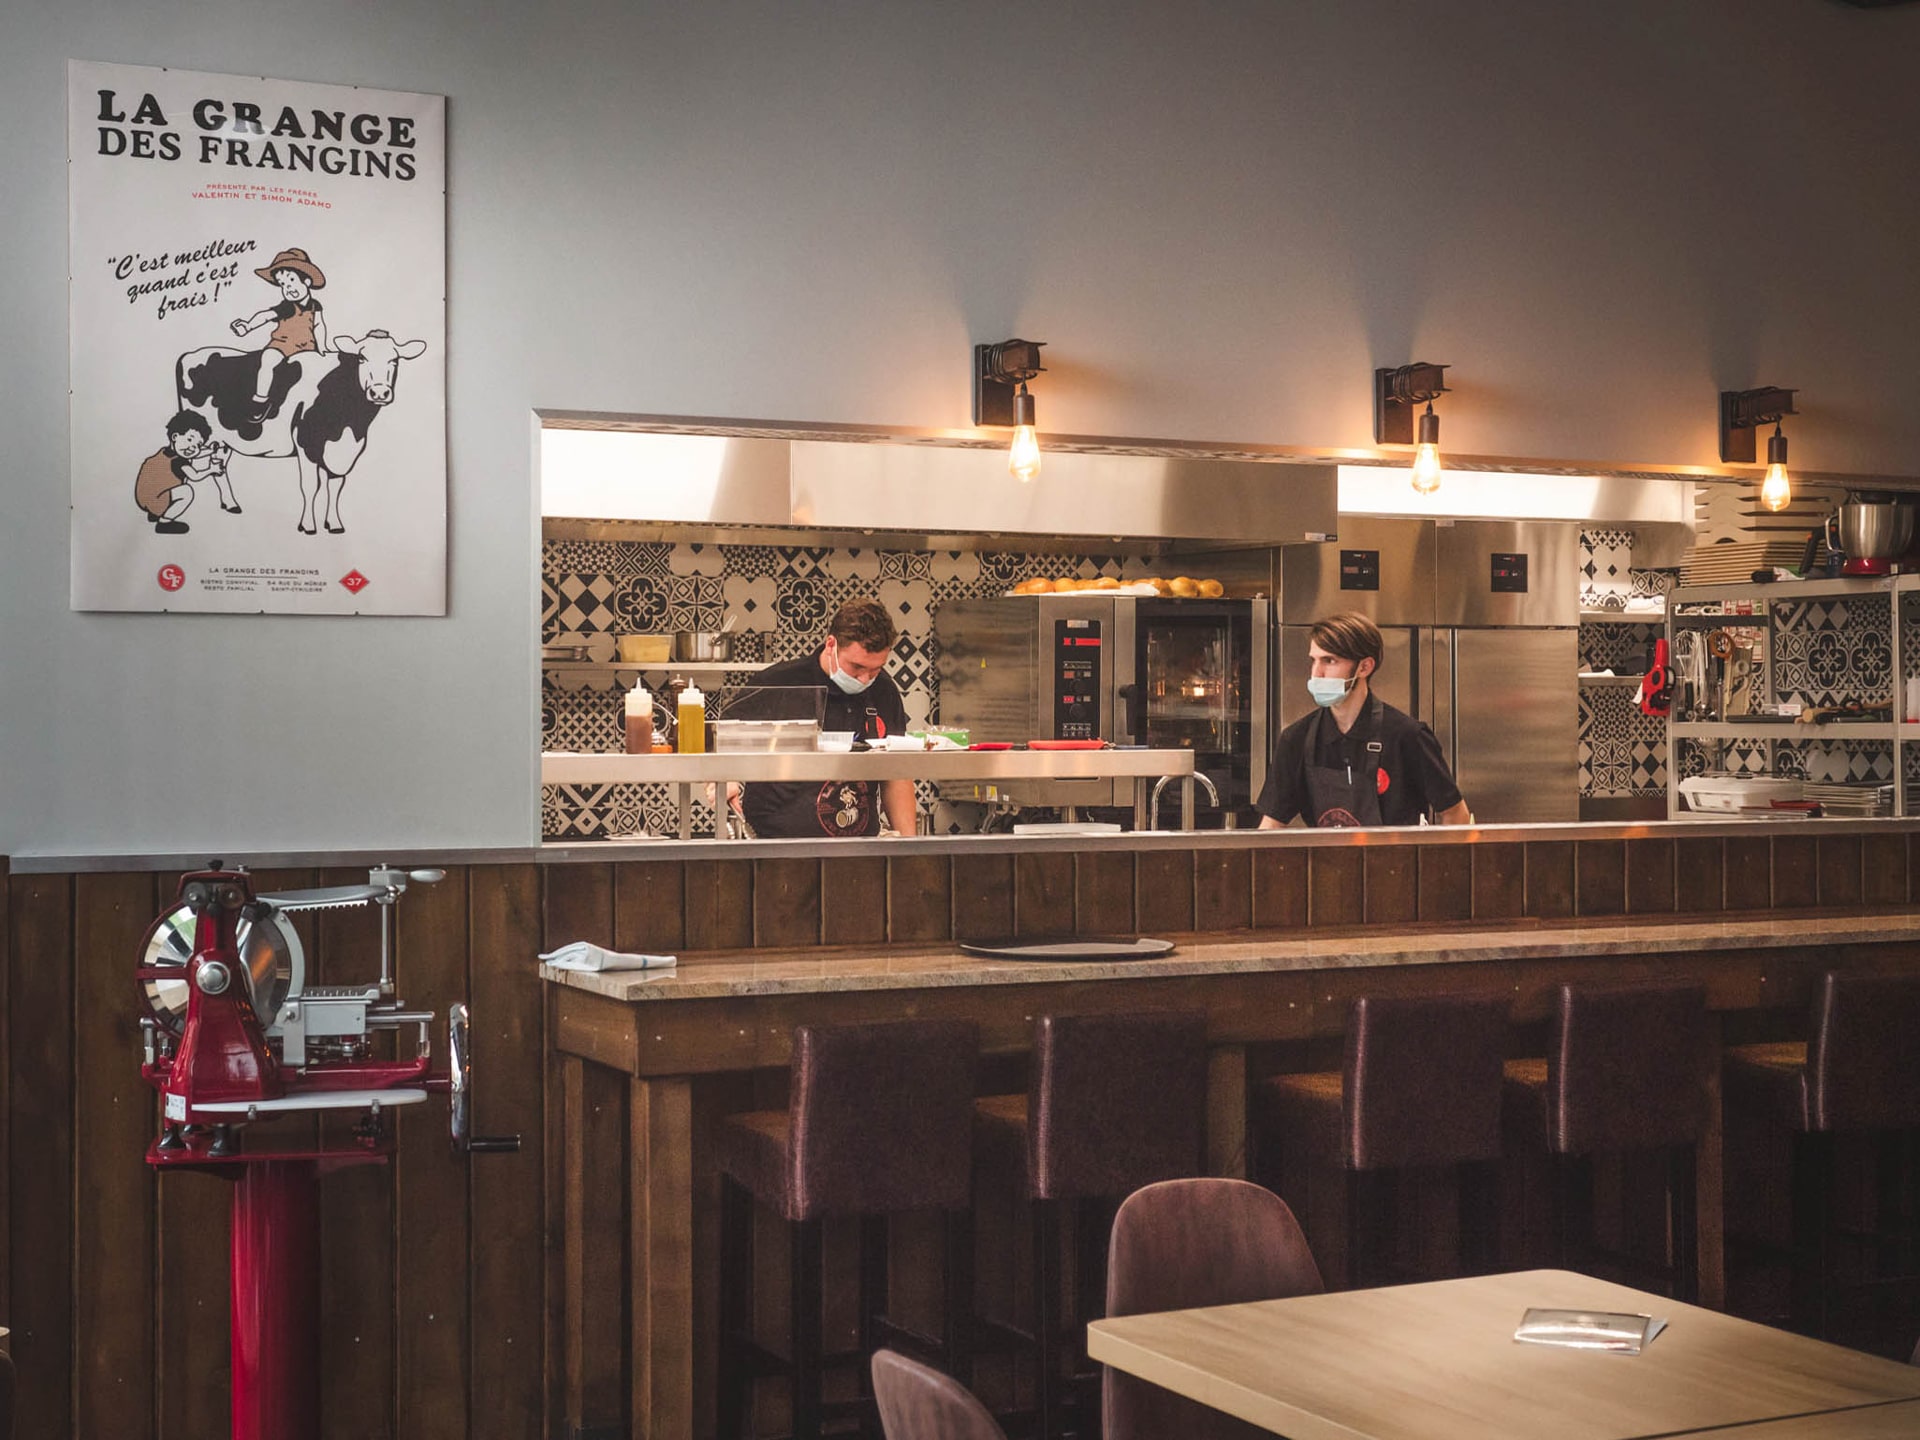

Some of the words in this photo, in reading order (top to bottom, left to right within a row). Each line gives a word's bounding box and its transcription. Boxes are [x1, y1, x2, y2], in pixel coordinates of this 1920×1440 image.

[97, 90, 168, 126] LA
[193, 99, 416, 149] GRANGE
[98, 127, 181, 161] DES
[199, 135, 417, 181] FRANGINS
[262, 194, 293, 203] SIMON
[297, 198, 332, 209] ADAMO
[174, 239, 257, 266] meilleur
[127, 269, 190, 304] quand
[196, 261, 239, 283] c'est
[158, 292, 208, 320] frais
[223, 567, 256, 575] GRANGE
[346, 577, 363, 586] 37
